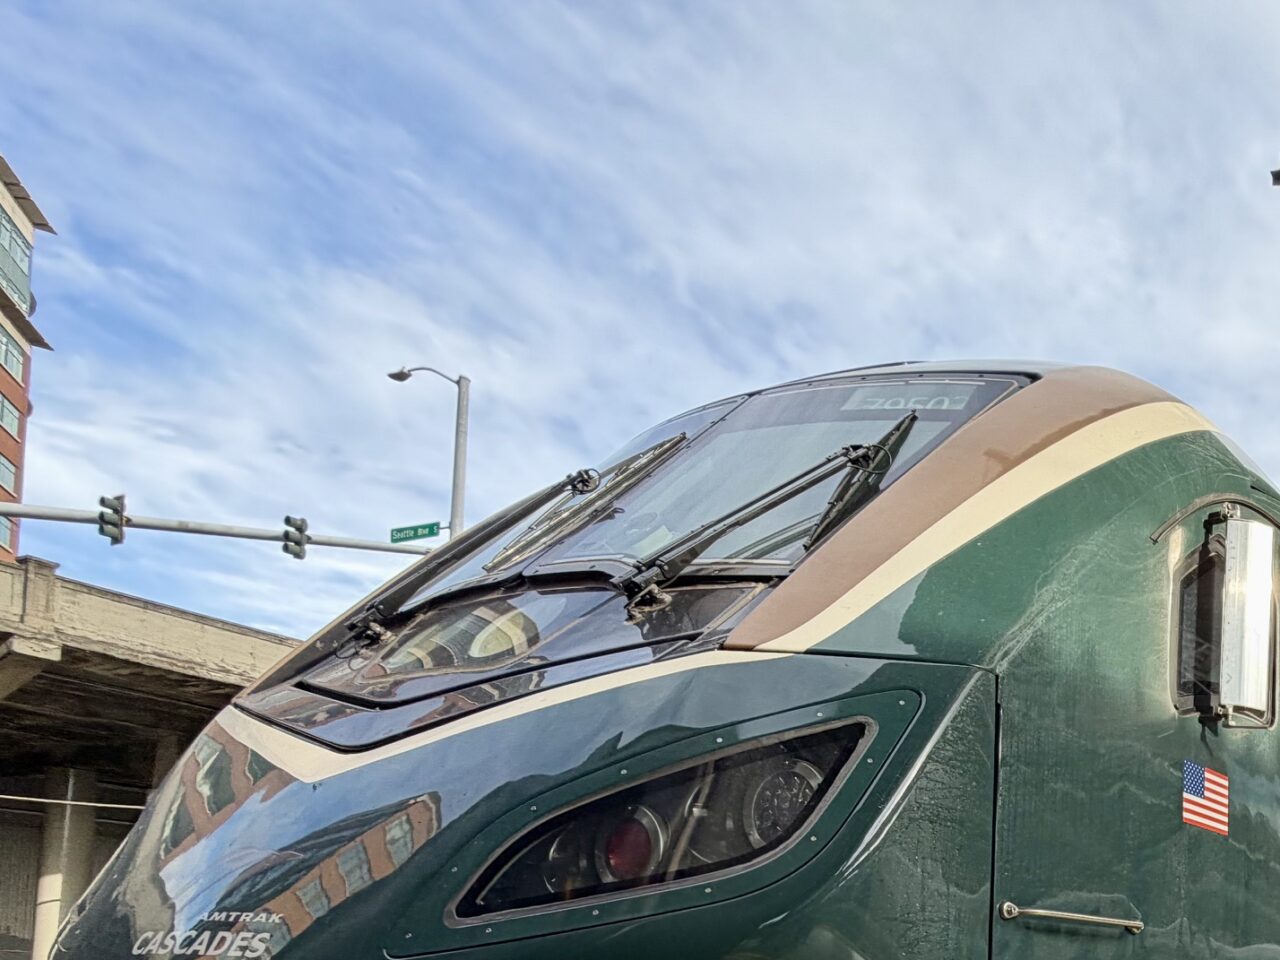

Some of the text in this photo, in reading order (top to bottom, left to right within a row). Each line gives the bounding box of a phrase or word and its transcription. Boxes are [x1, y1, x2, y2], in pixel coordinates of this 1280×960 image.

[392, 530, 414, 540] Seattle
[201, 911, 285, 924] AMTRAK
[131, 930, 272, 959] CASCADES
